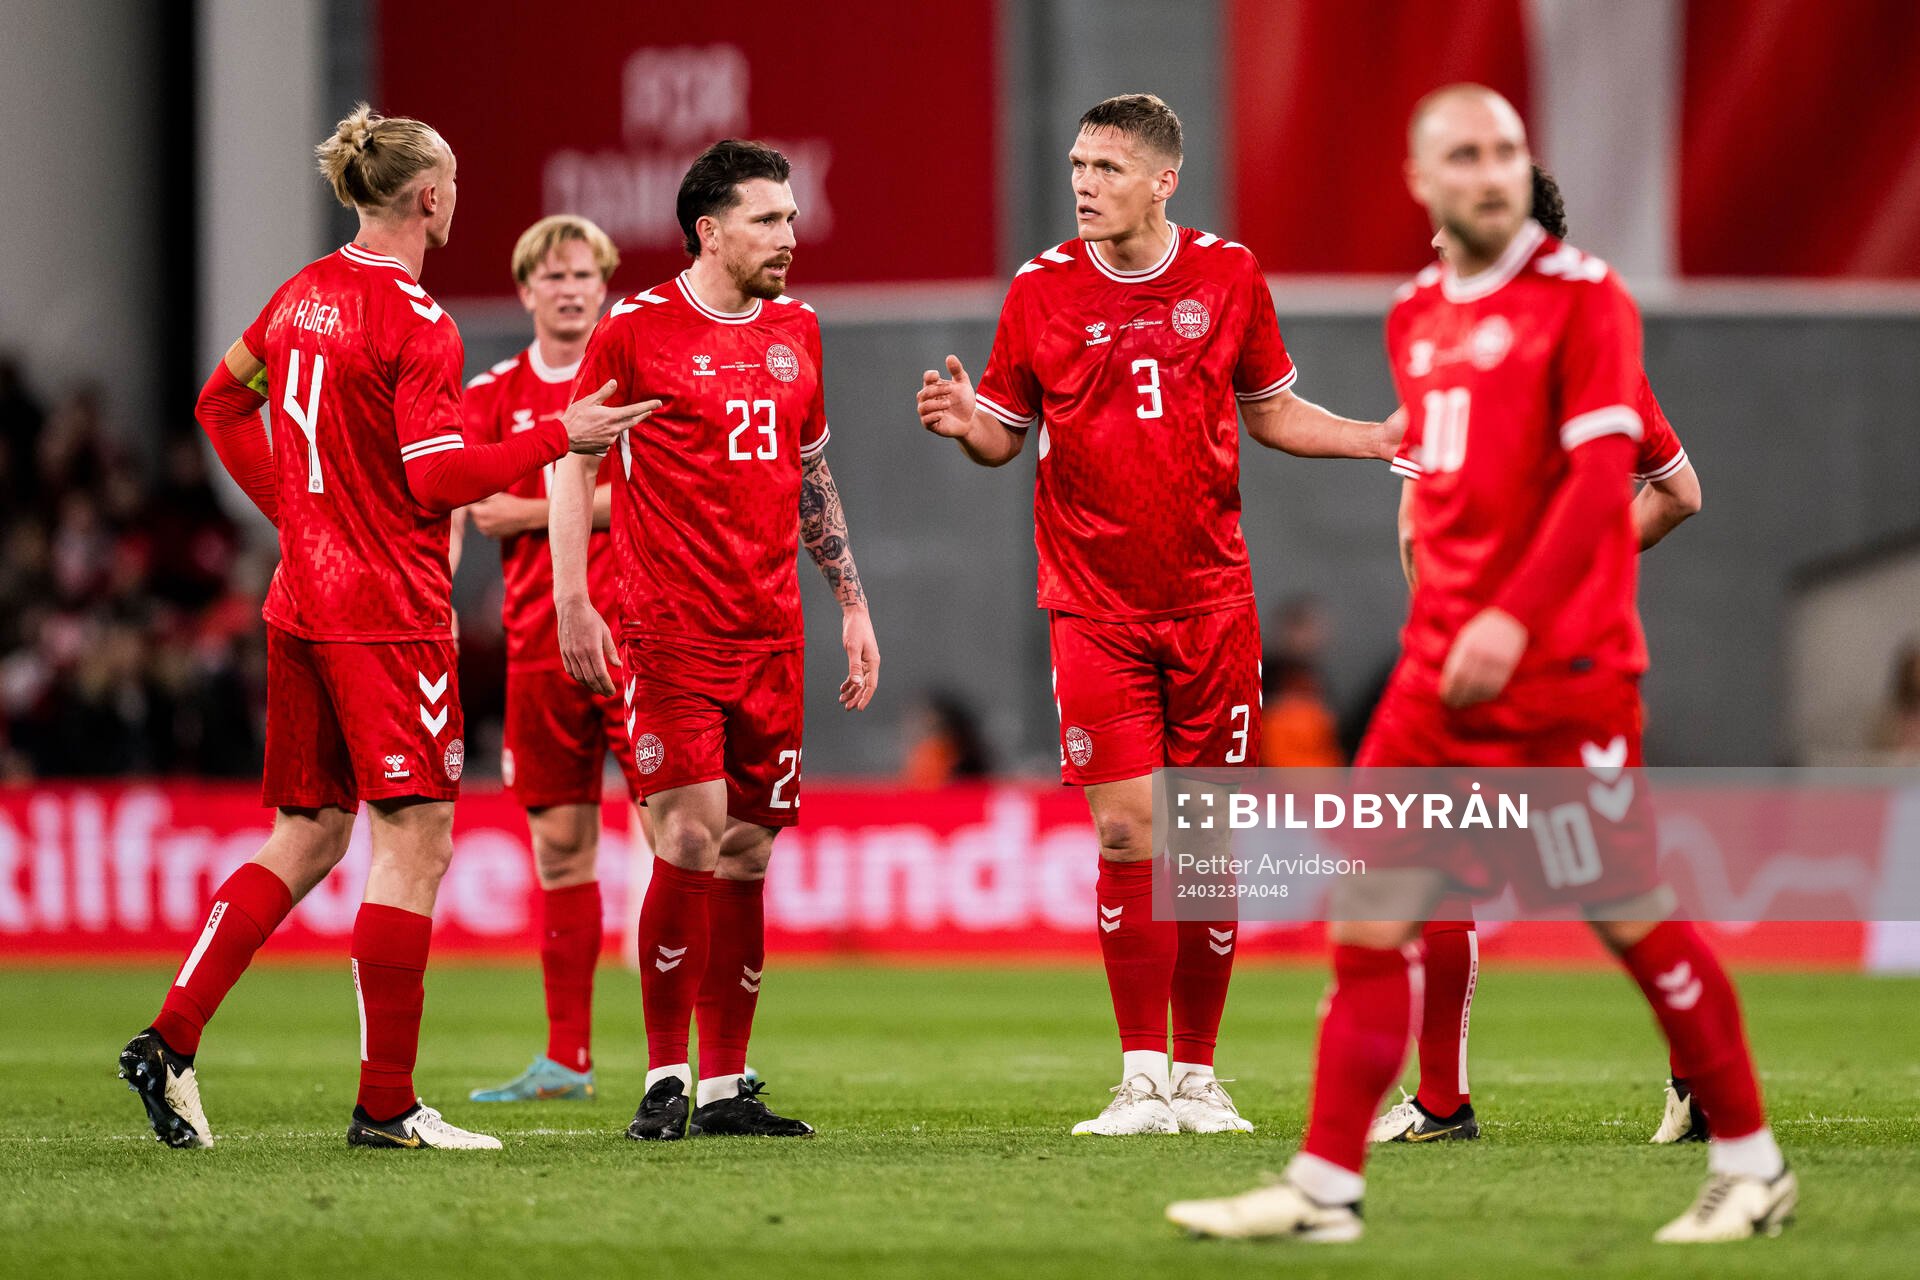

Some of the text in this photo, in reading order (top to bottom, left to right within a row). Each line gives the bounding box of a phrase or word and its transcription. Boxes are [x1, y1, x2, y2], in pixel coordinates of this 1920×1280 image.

[293, 299, 339, 336] KJÆR
[1180, 312, 1202, 325] DBU
[1131, 358, 1164, 419] 3
[283, 349, 325, 494] 4
[725, 399, 778, 461] 23
[1225, 704, 1250, 764] 3
[1529, 801, 1603, 889] 10
[207, 900, 224, 929] ARK
